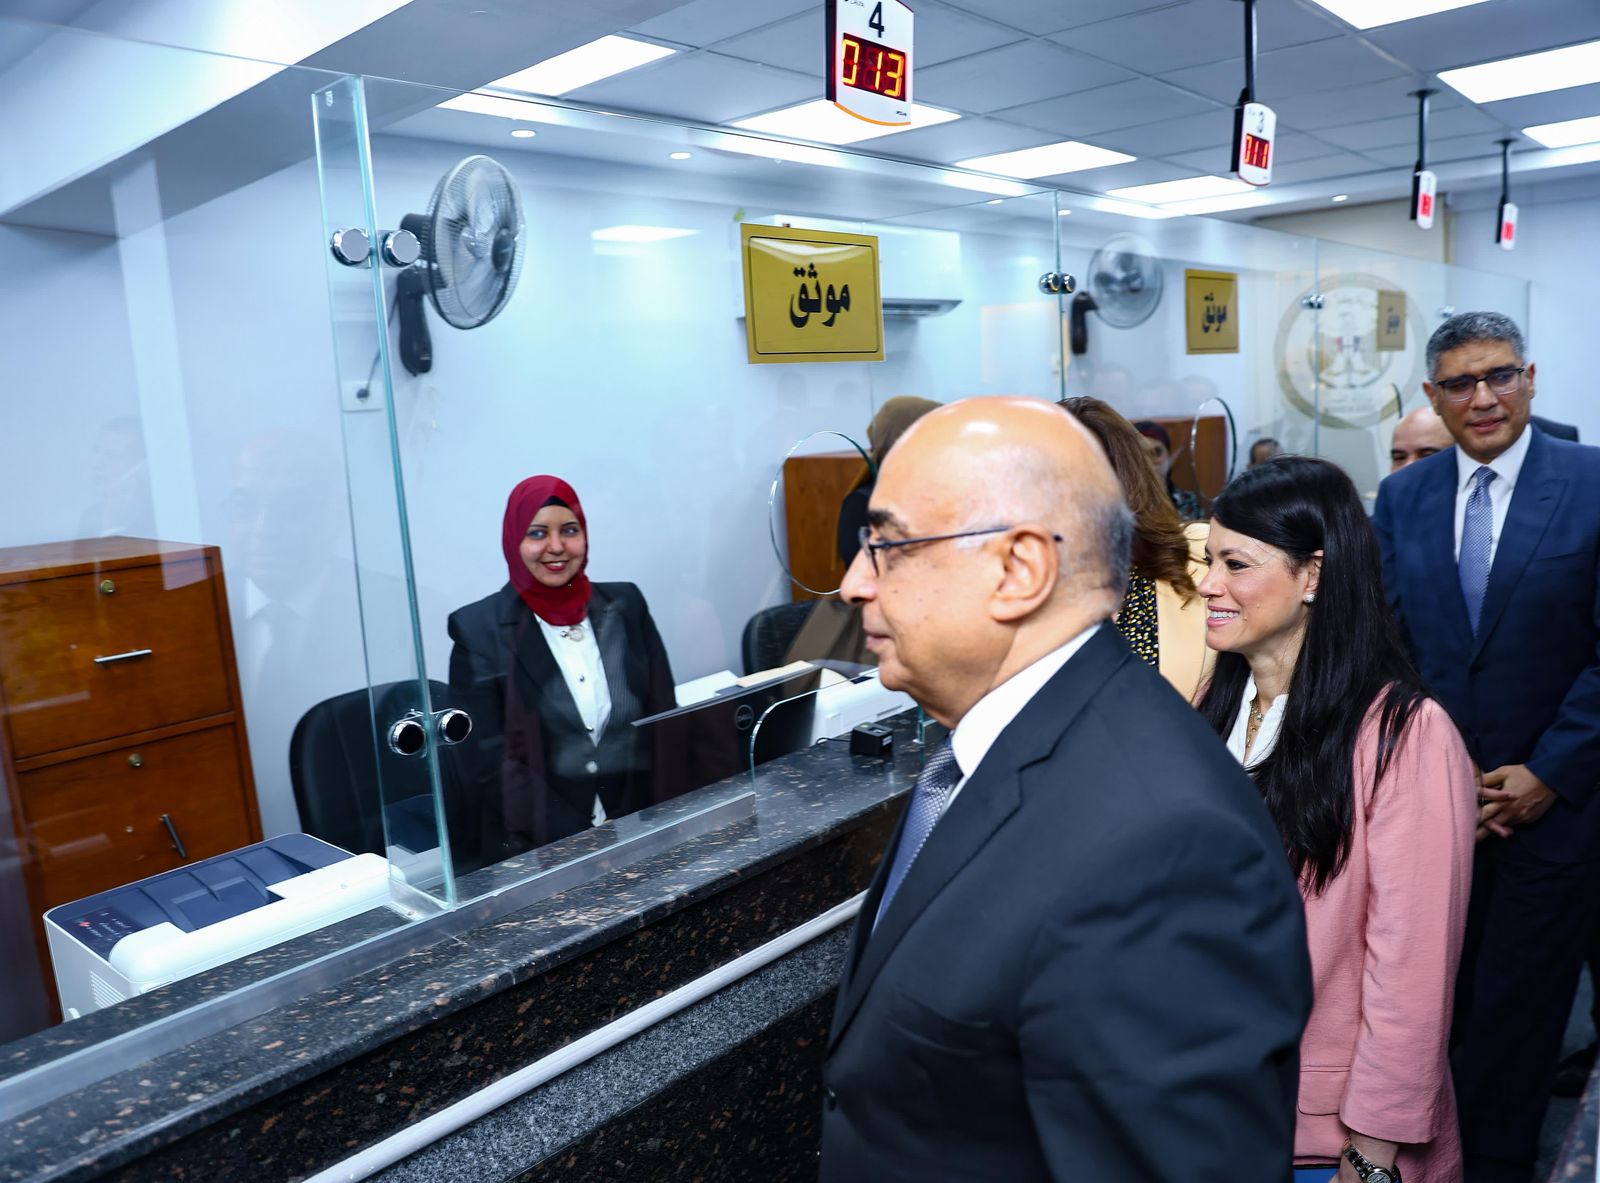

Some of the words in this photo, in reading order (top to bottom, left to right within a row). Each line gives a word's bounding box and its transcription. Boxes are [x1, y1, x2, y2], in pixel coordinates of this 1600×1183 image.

[868, 1, 885, 38] 4
[841, 38, 905, 98] 013
[789, 262, 851, 329] موثق
[1202, 292, 1227, 334] موثق
